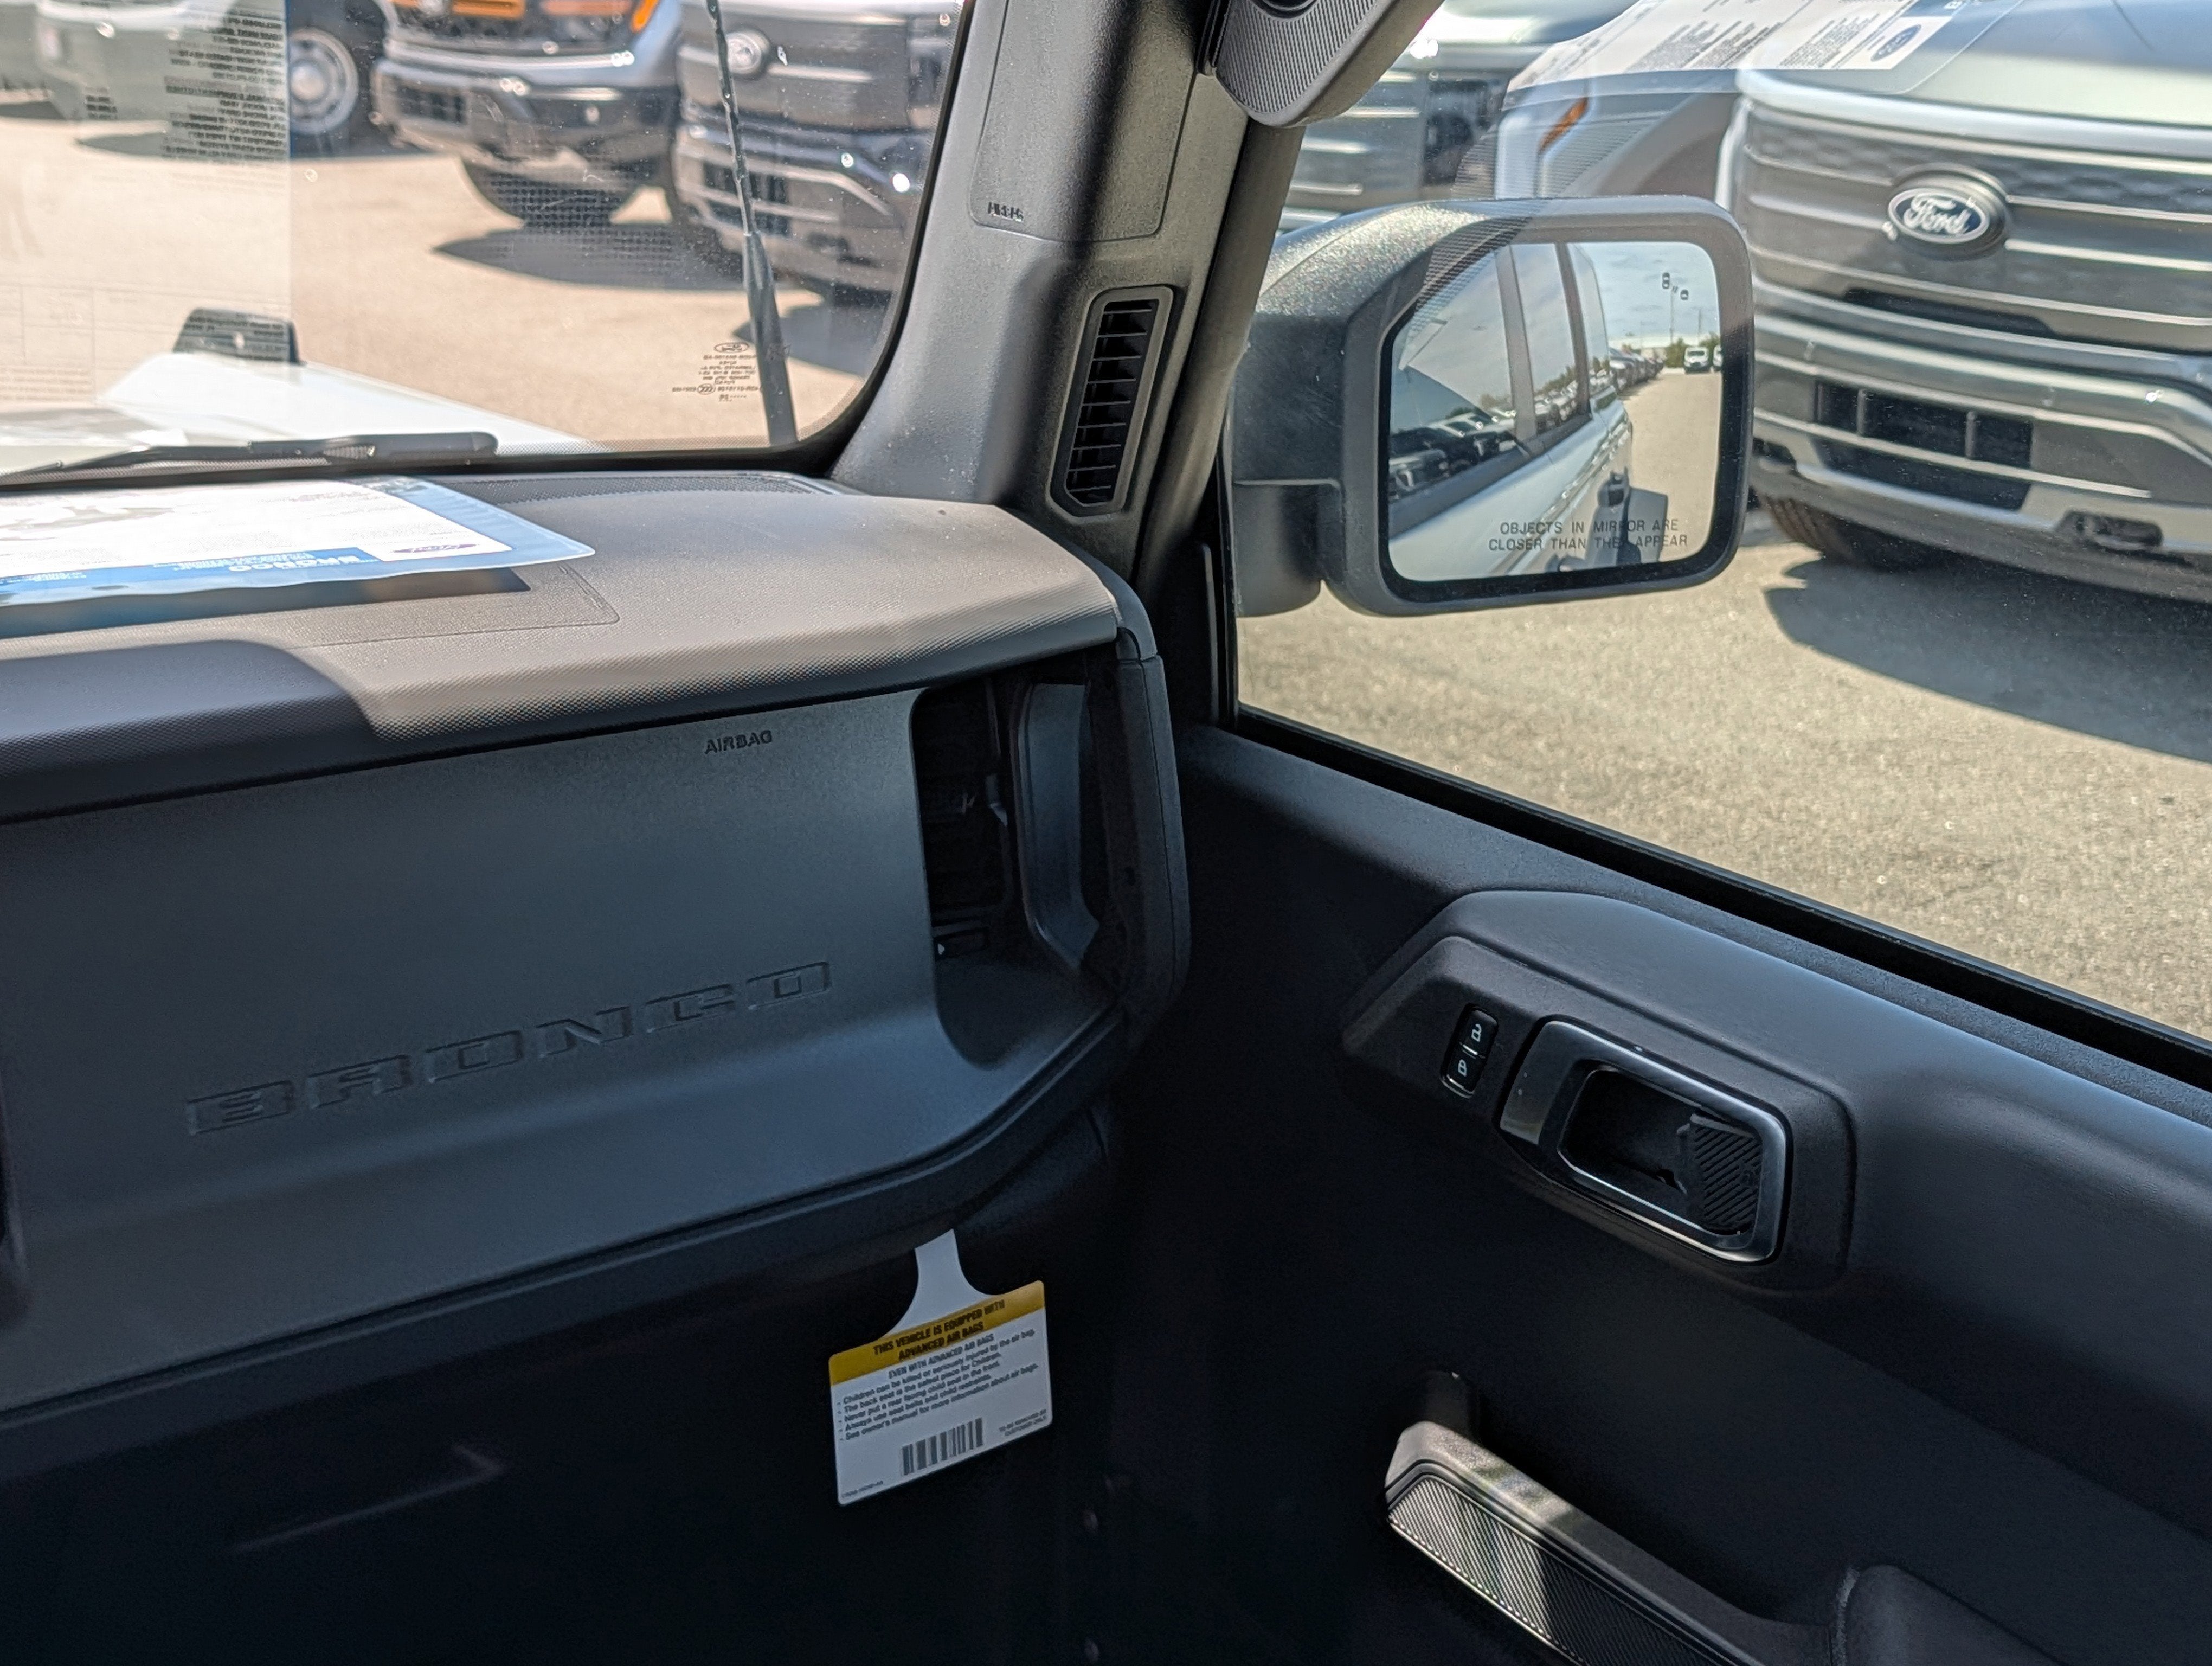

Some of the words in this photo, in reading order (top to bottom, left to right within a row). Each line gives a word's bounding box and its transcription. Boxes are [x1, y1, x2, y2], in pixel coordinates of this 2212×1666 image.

[1901, 191, 1973, 235] Ford
[1500, 521, 1563, 535] OBJECTS
[1571, 521, 1585, 533] IN
[1652, 518, 1679, 531] ARE
[1488, 537, 1542, 551] CLOSER
[1552, 536, 1586, 550] THAN
[1594, 536, 1629, 549] THE
[1636, 534, 1687, 547] APPEAR
[705, 730, 773, 754] AIRBAG
[185, 960, 831, 1136] BRONCO
[873, 1341, 894, 1355] THIS
[934, 1325, 942, 1335] IS
[947, 1331, 961, 1344] AIR
[962, 1322, 983, 1337] BAGS
